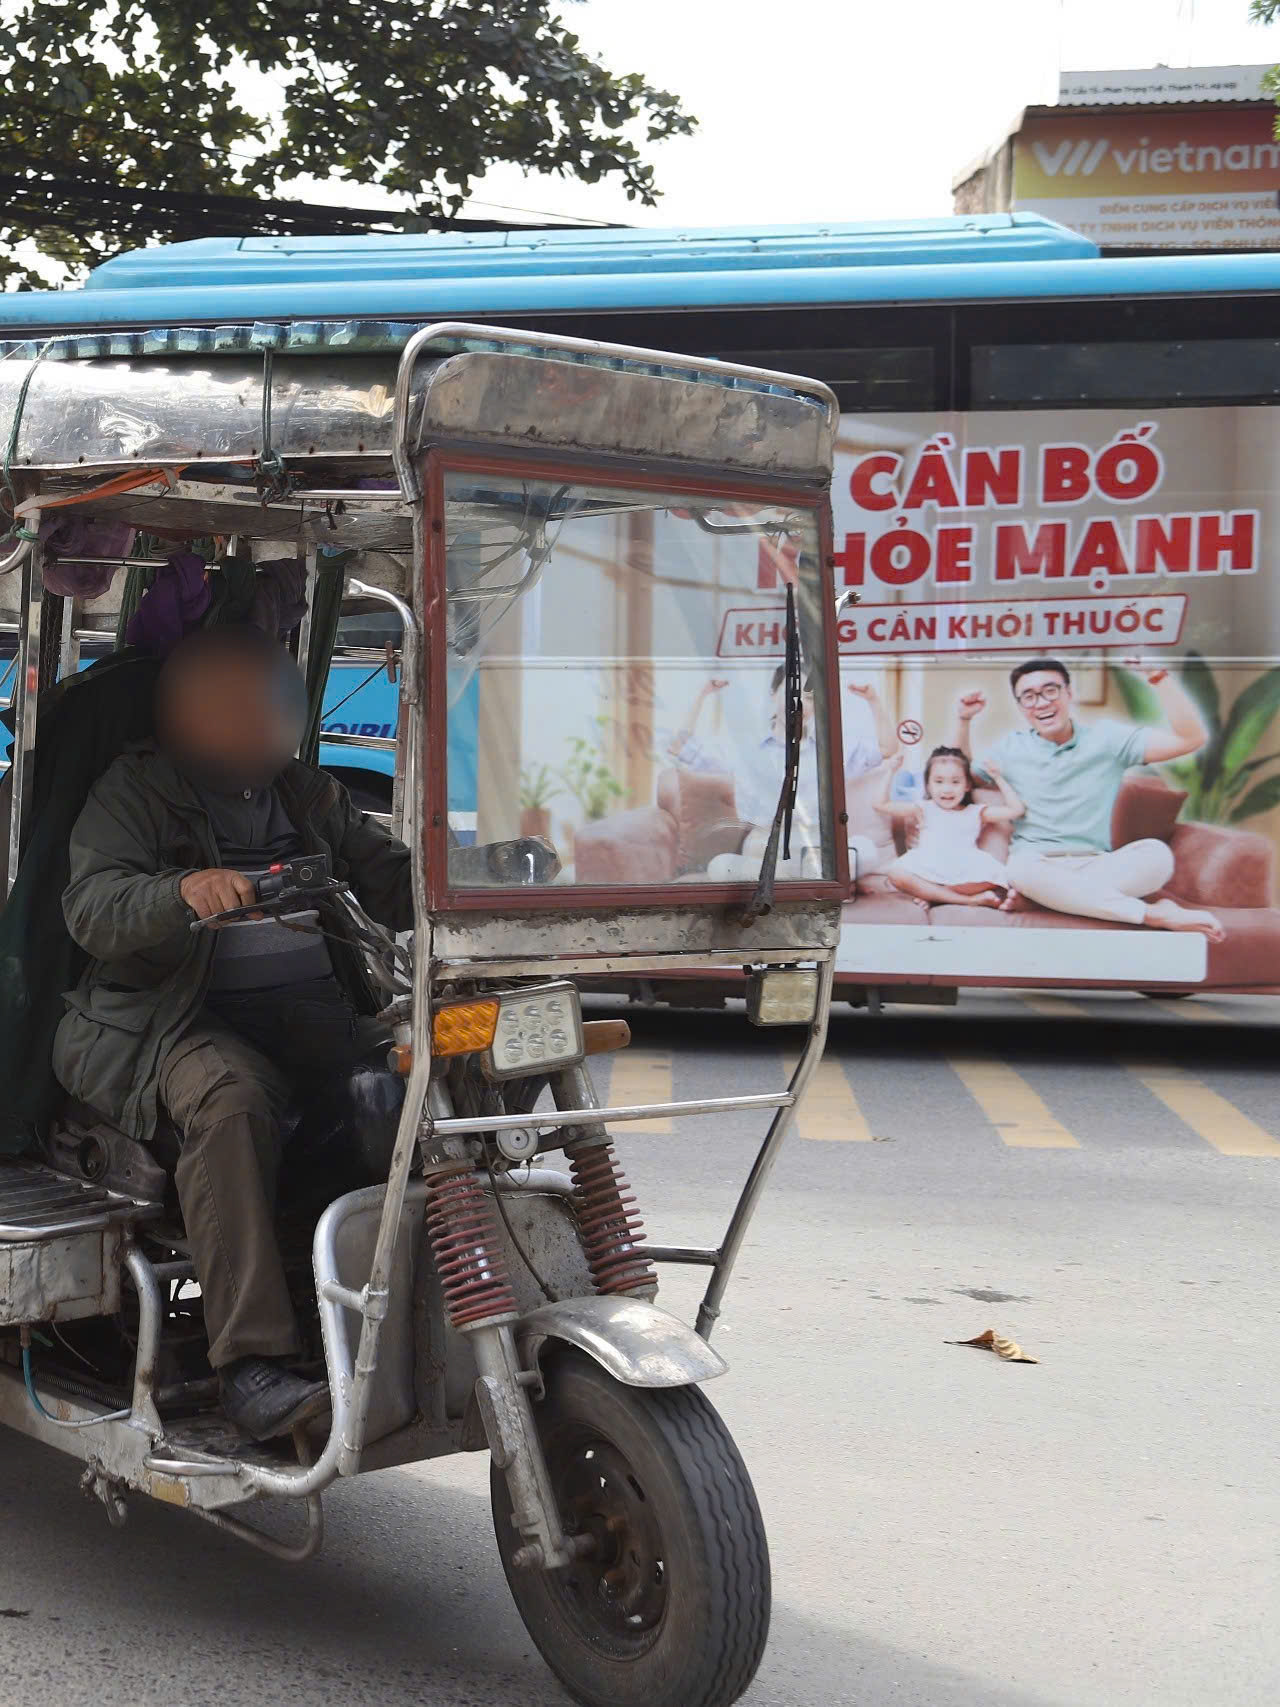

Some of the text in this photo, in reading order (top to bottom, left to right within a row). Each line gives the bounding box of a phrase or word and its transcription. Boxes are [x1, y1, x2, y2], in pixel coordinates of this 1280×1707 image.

[849, 426, 1160, 512] CẦN BỐ
[995, 513, 1255, 591] MẠNH
[735, 619, 857, 646] KHG
[866, 610, 937, 642] CẦN
[1043, 602, 1164, 637] THUỐC
